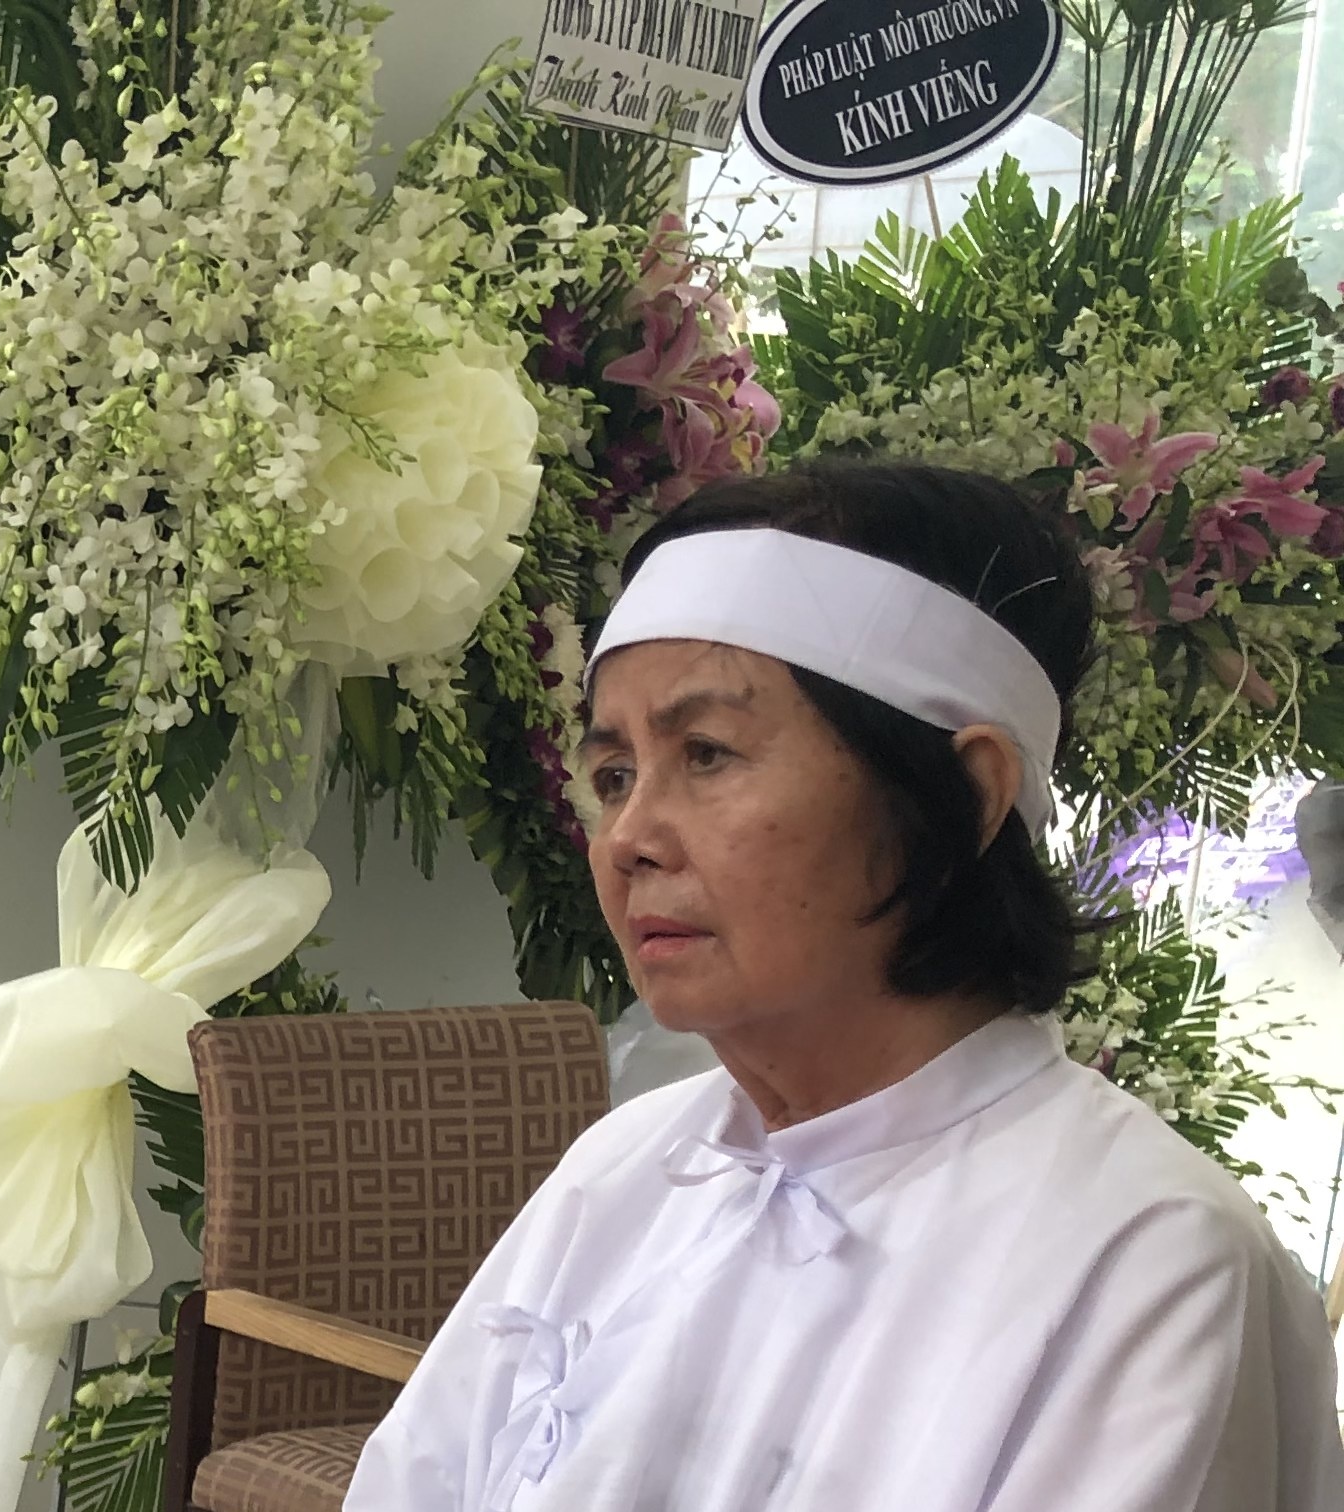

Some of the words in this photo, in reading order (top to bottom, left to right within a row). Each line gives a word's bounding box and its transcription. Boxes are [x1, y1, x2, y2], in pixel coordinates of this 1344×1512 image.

[778, 44, 827, 99] PHÁP
[827, 32, 876, 82] LUẬT
[878, 10, 921, 62] MÔI
[834, 89, 914, 157] KÍNH
[910, 58, 999, 128] VIẾNG
